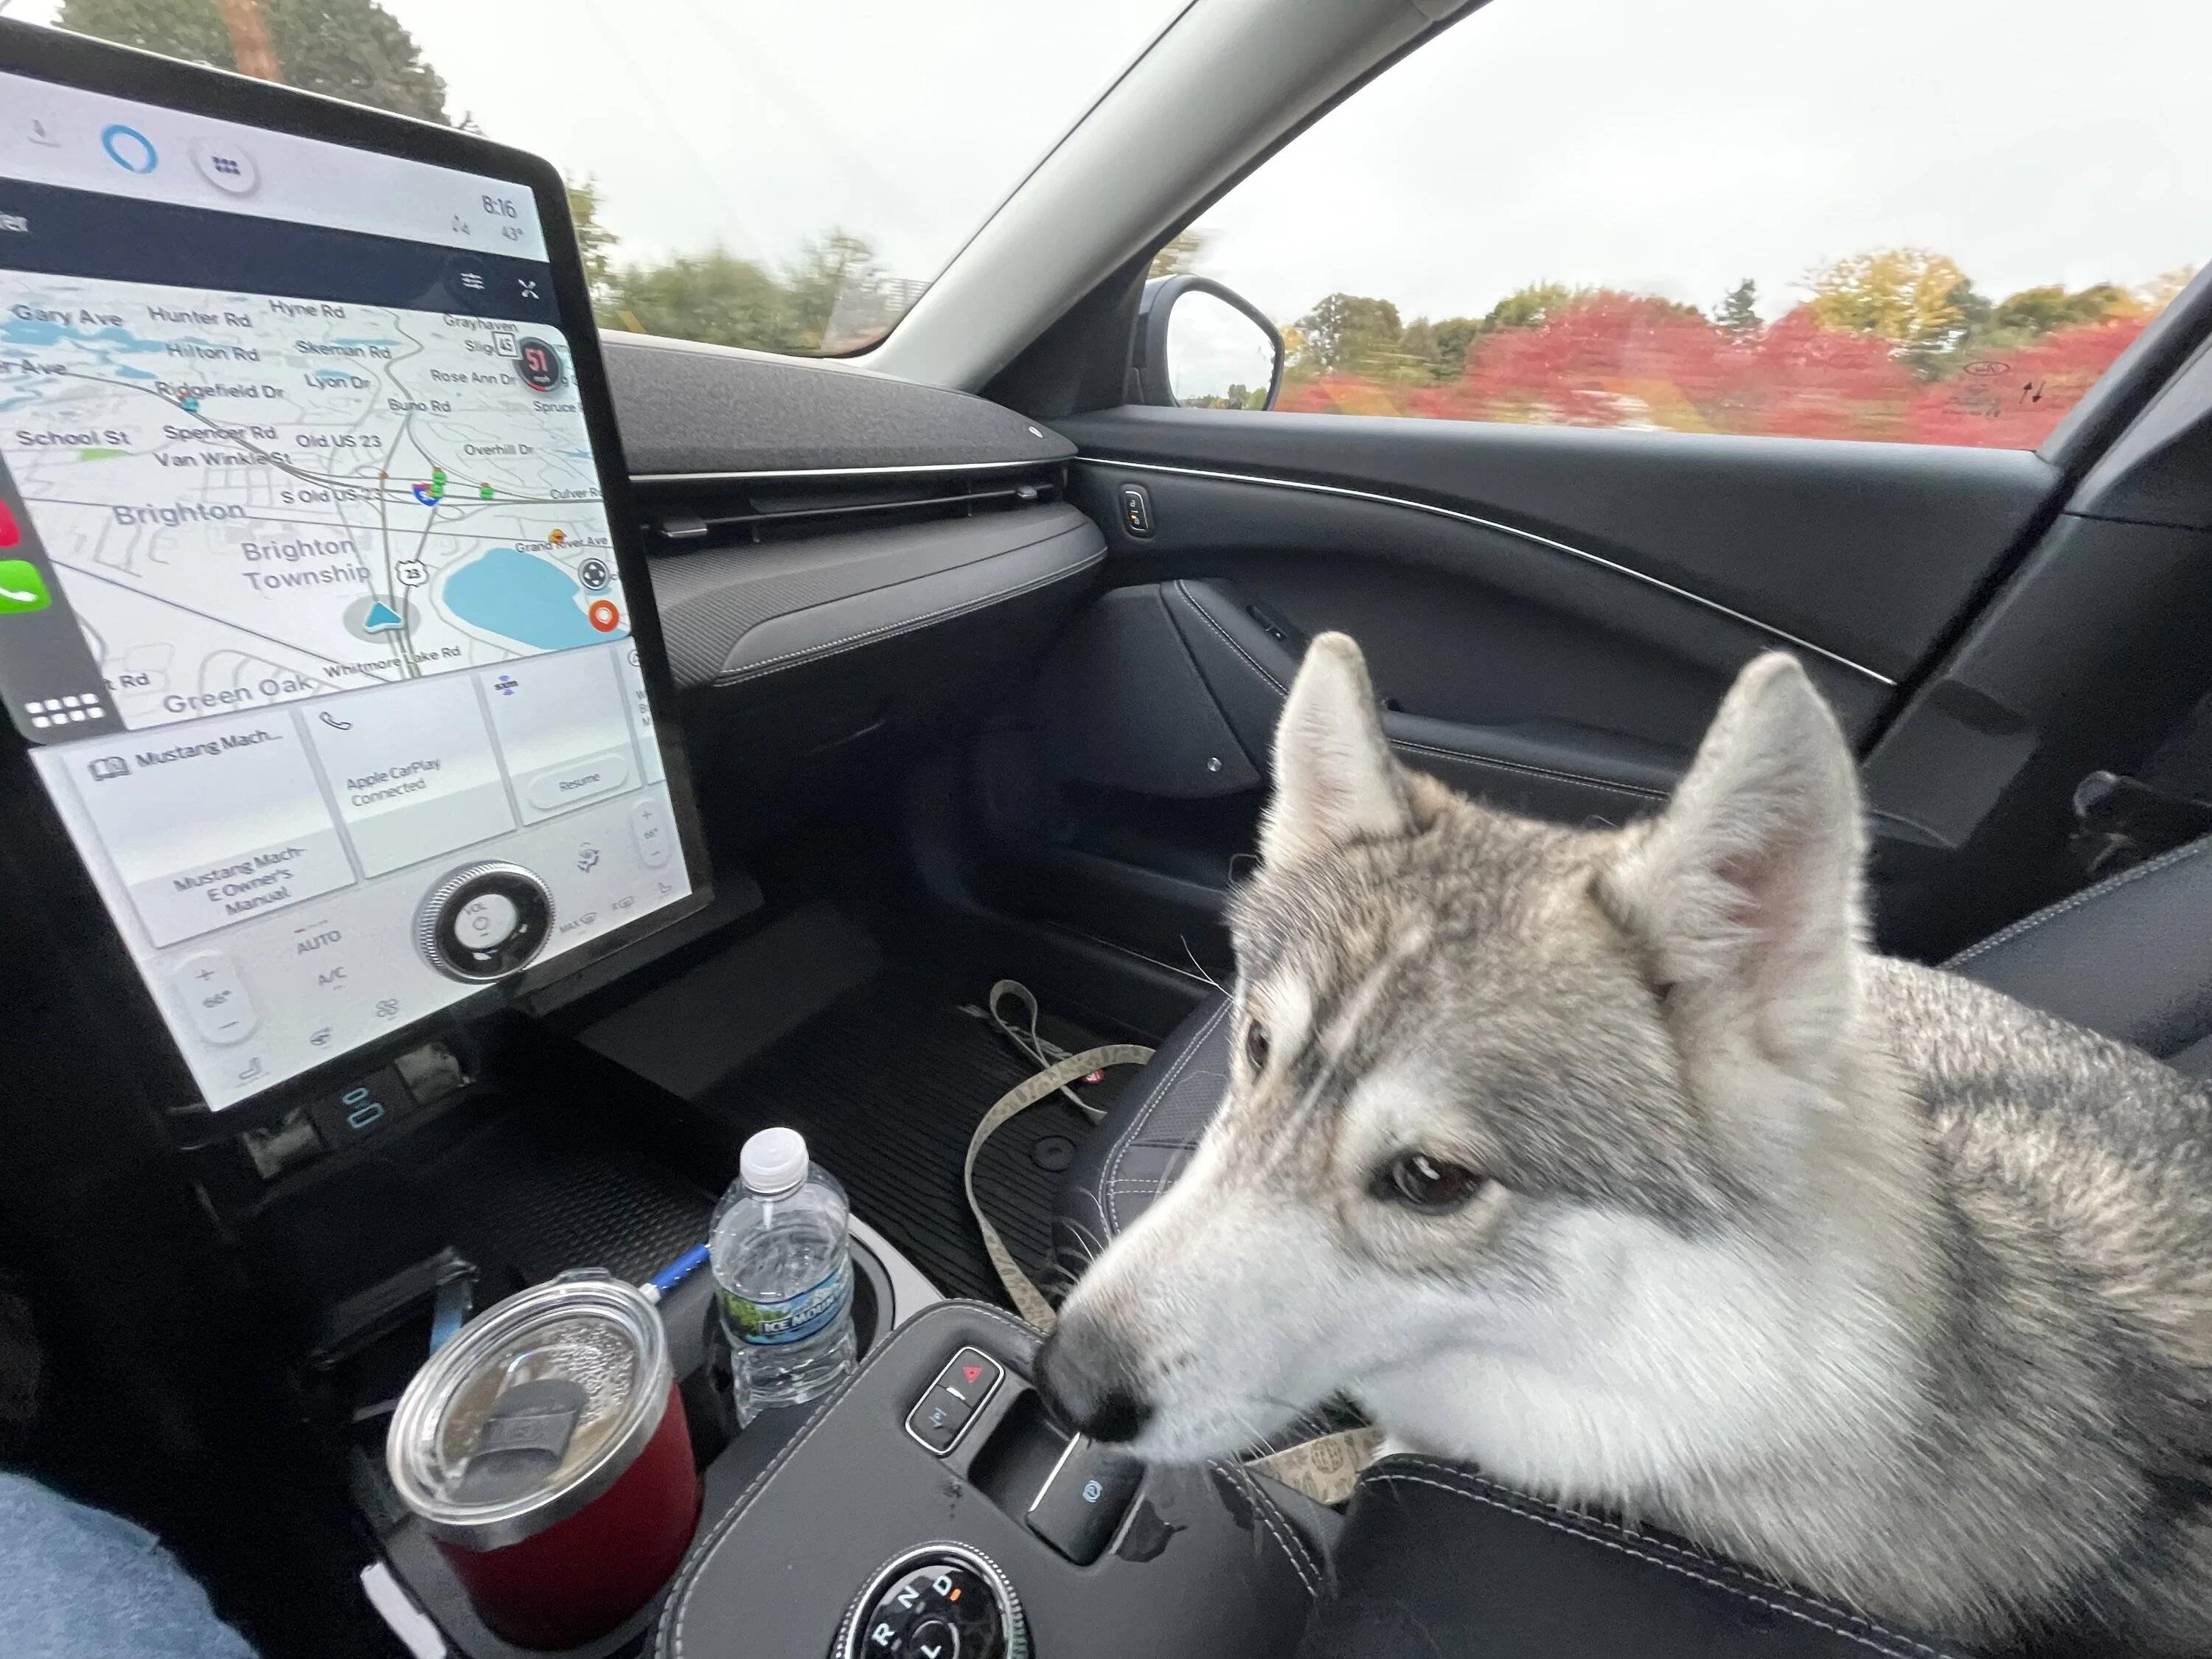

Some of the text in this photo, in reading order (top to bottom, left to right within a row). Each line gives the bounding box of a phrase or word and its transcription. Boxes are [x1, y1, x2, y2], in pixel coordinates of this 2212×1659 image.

[482, 195, 518, 218] 8:16
[10, 305, 124, 327] Gary Ave
[148, 307, 252, 328] Hunter Rd
[268, 299, 347, 319] Hyne Rd
[443, 314, 520, 333] Grayhaven
[165, 342, 260, 362] Hilton Rd
[369, 346, 392, 359] Rd
[304, 373, 371, 390] Lyon Dr
[431, 369, 468, 383] Rose
[472, 372, 498, 384] Ann
[261, 385, 285, 399] Dr
[430, 400, 451, 412] Rd
[533, 400, 577, 414] Spruce
[16, 430, 132, 446] School St
[163, 425, 278, 442] Spencer Rd
[296, 434, 383, 448] Old US 23
[153, 451, 198, 467] Van
[269, 451, 293, 465] St
[464, 444, 535, 456] Overhill Dr
[280, 490, 295, 504] S
[298, 490, 331, 503] Old
[550, 489, 587, 499] Culver
[112, 503, 246, 526] Brighton
[240, 540, 355, 563] Brighton
[515, 541, 553, 553] Grand
[587, 537, 608, 545] Ave
[242, 564, 370, 591] Township
[441, 646, 462, 658] Rd
[118, 672, 150, 688] Rd
[162, 675, 315, 713] Green Oak
[135, 741, 221, 768] Mustang
[347, 758, 442, 791] Apple CarPlay
[559, 773, 602, 792] Resume
[351, 776, 428, 807] Connected
[173, 861, 254, 891] Mustang
[206, 888, 223, 902] E
[224, 886, 292, 916] Manual
[297, 931, 342, 955] AUTO
[318, 966, 348, 987] A/C
[933, 1575, 953, 1596] D
[897, 1585, 920, 1609] N
[872, 1623, 894, 1646] R
